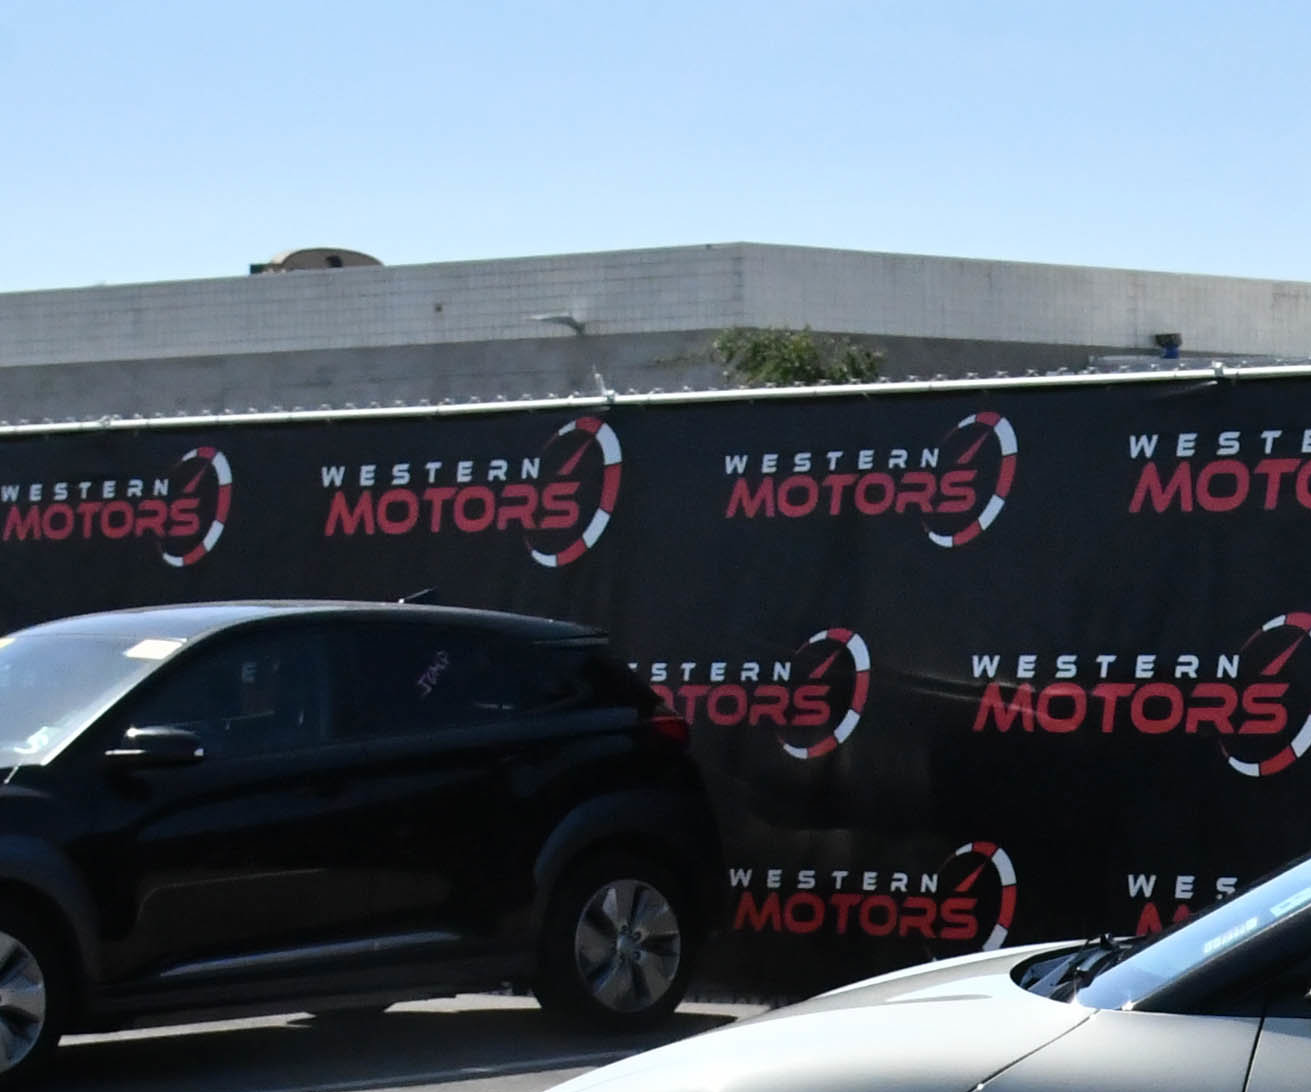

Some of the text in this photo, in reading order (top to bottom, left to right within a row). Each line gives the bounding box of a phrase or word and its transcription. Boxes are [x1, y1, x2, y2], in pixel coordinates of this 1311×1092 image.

[322, 458, 539, 486] WESTERN
[726, 449, 938, 474] WESTERN
[2, 480, 168, 501] WESTERN
[728, 470, 976, 517] MOTORS
[5, 499, 199, 539] MOTORS
[325, 482, 579, 536] MOTORS
[629, 663, 790, 681] STERN
[973, 655, 1239, 678] WESTERN
[648, 685, 830, 725] TORS
[974, 683, 1288, 733] MOTORS
[731, 870, 937, 892] WESTERN
[732, 894, 976, 938] MOTORS
